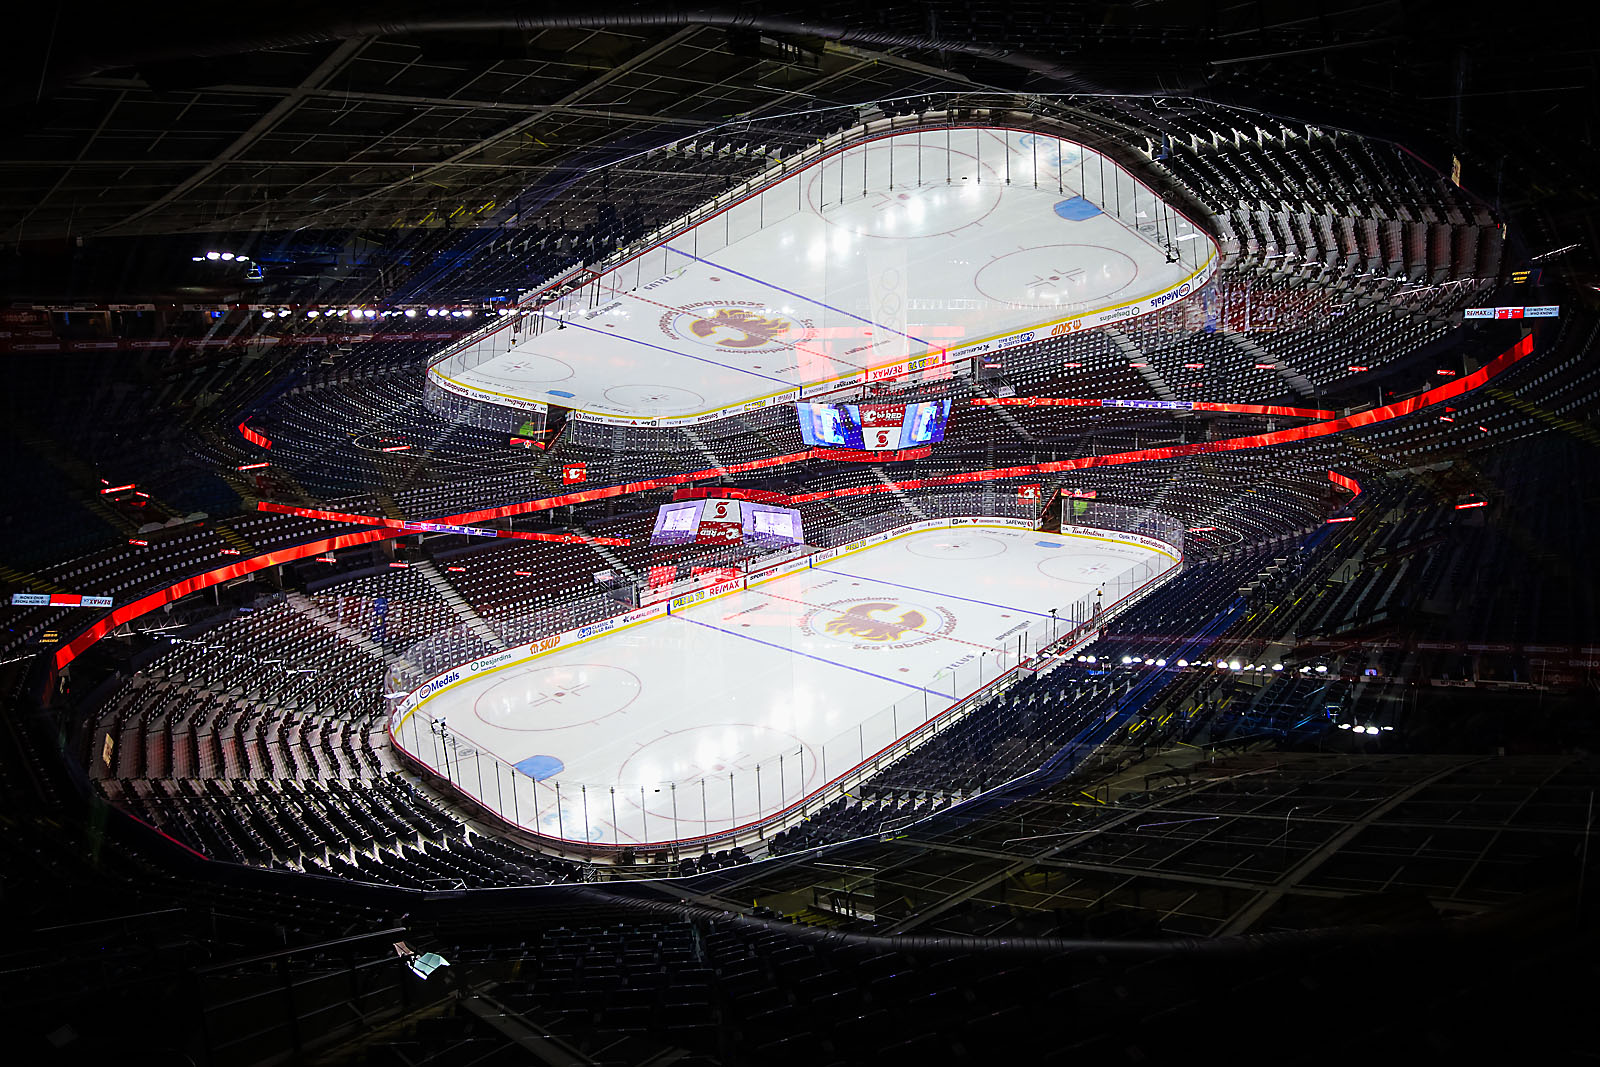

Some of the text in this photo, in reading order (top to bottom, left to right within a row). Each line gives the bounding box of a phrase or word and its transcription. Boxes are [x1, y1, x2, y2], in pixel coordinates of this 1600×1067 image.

[1150, 290, 1180, 308] Medals
[1099, 309, 1130, 322] Desjardins
[1050, 321, 1072, 336] SKIP
[908, 356, 940, 371] PIZZA 73
[872, 364, 902, 379] RE/MAX
[751, 400, 766, 408] PIZZA
[581, 414, 604, 422] SAFEWAY
[696, 412, 719, 422] Scotiabank
[891, 526, 913, 536] Scotiabank
[845, 542, 860, 552] PIZZA
[709, 580, 740, 597] RE/MAX
[673, 590, 705, 608] PIZZA 73
[540, 636, 560, 652] SKIP
[480, 654, 512, 668] Desjardins
[430, 671, 460, 692] Medals
